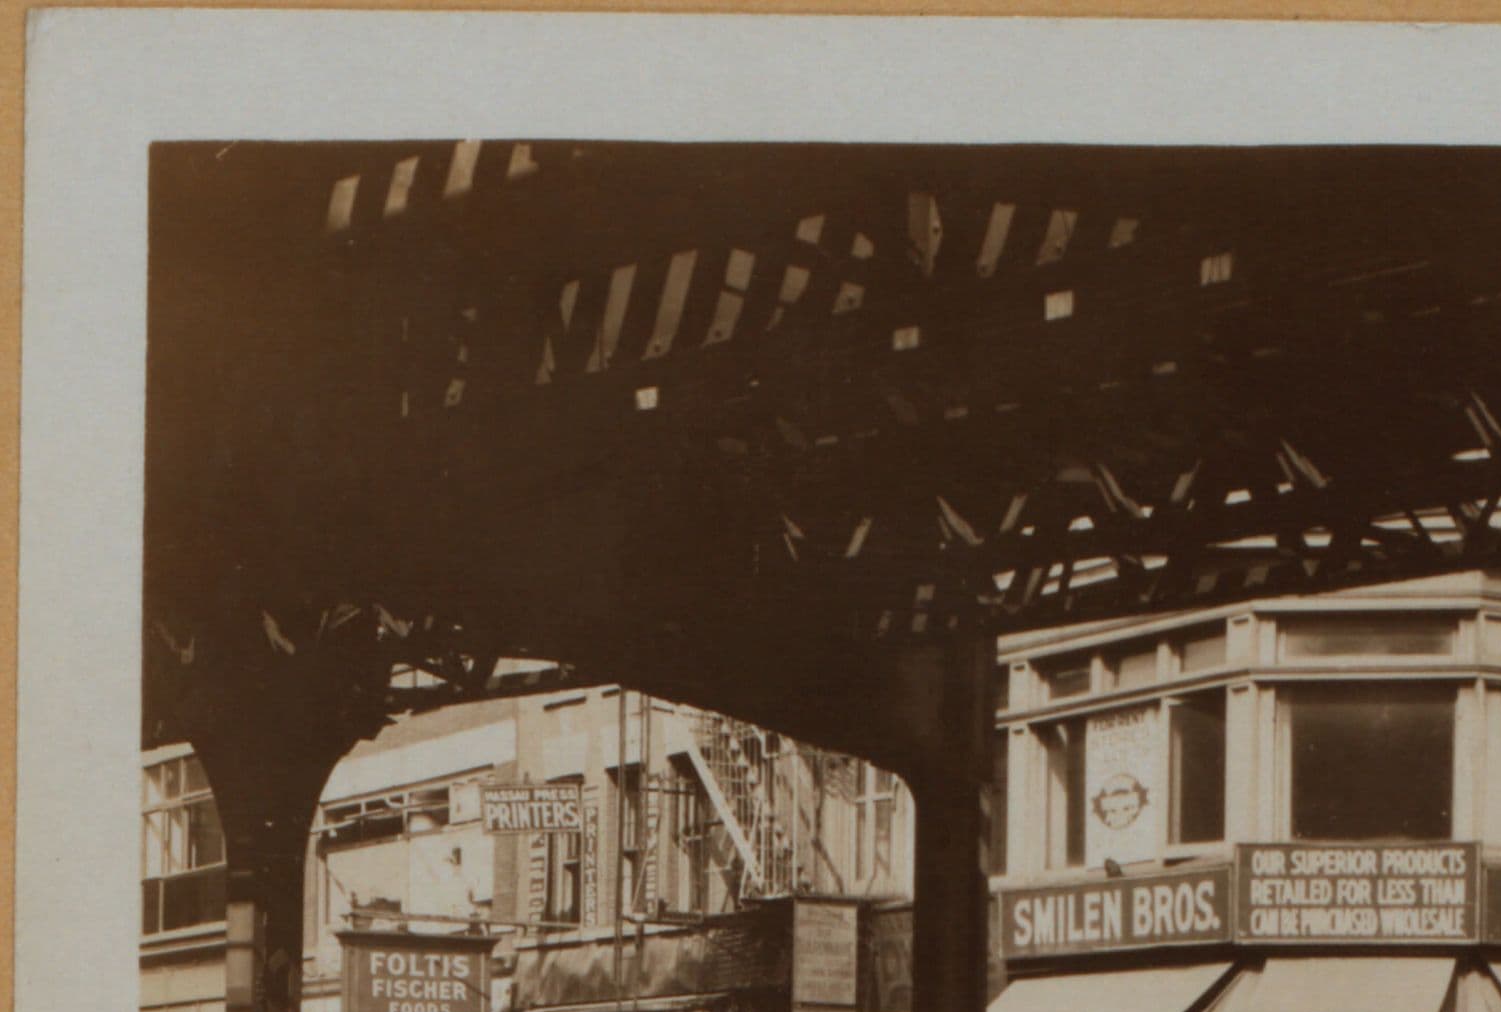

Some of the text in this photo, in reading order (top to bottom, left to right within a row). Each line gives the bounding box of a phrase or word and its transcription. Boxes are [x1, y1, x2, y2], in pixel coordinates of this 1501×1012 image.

[485, 801, 580, 832] PRINTERS
[583, 807, 598, 926] PRINTERS
[1250, 850, 1467, 876] OUR SUPERIOR PRODUCTS
[1250, 878, 1467, 905] RETAILED FOR LESS THAN
[1013, 880, 1221, 946] SMILEN BROS.
[1250, 908, 1466, 937] CAN BE PURCHASED WHOLESALE
[370, 952, 470, 978] FOLTIS
[371, 978, 467, 1001] FISCHER
